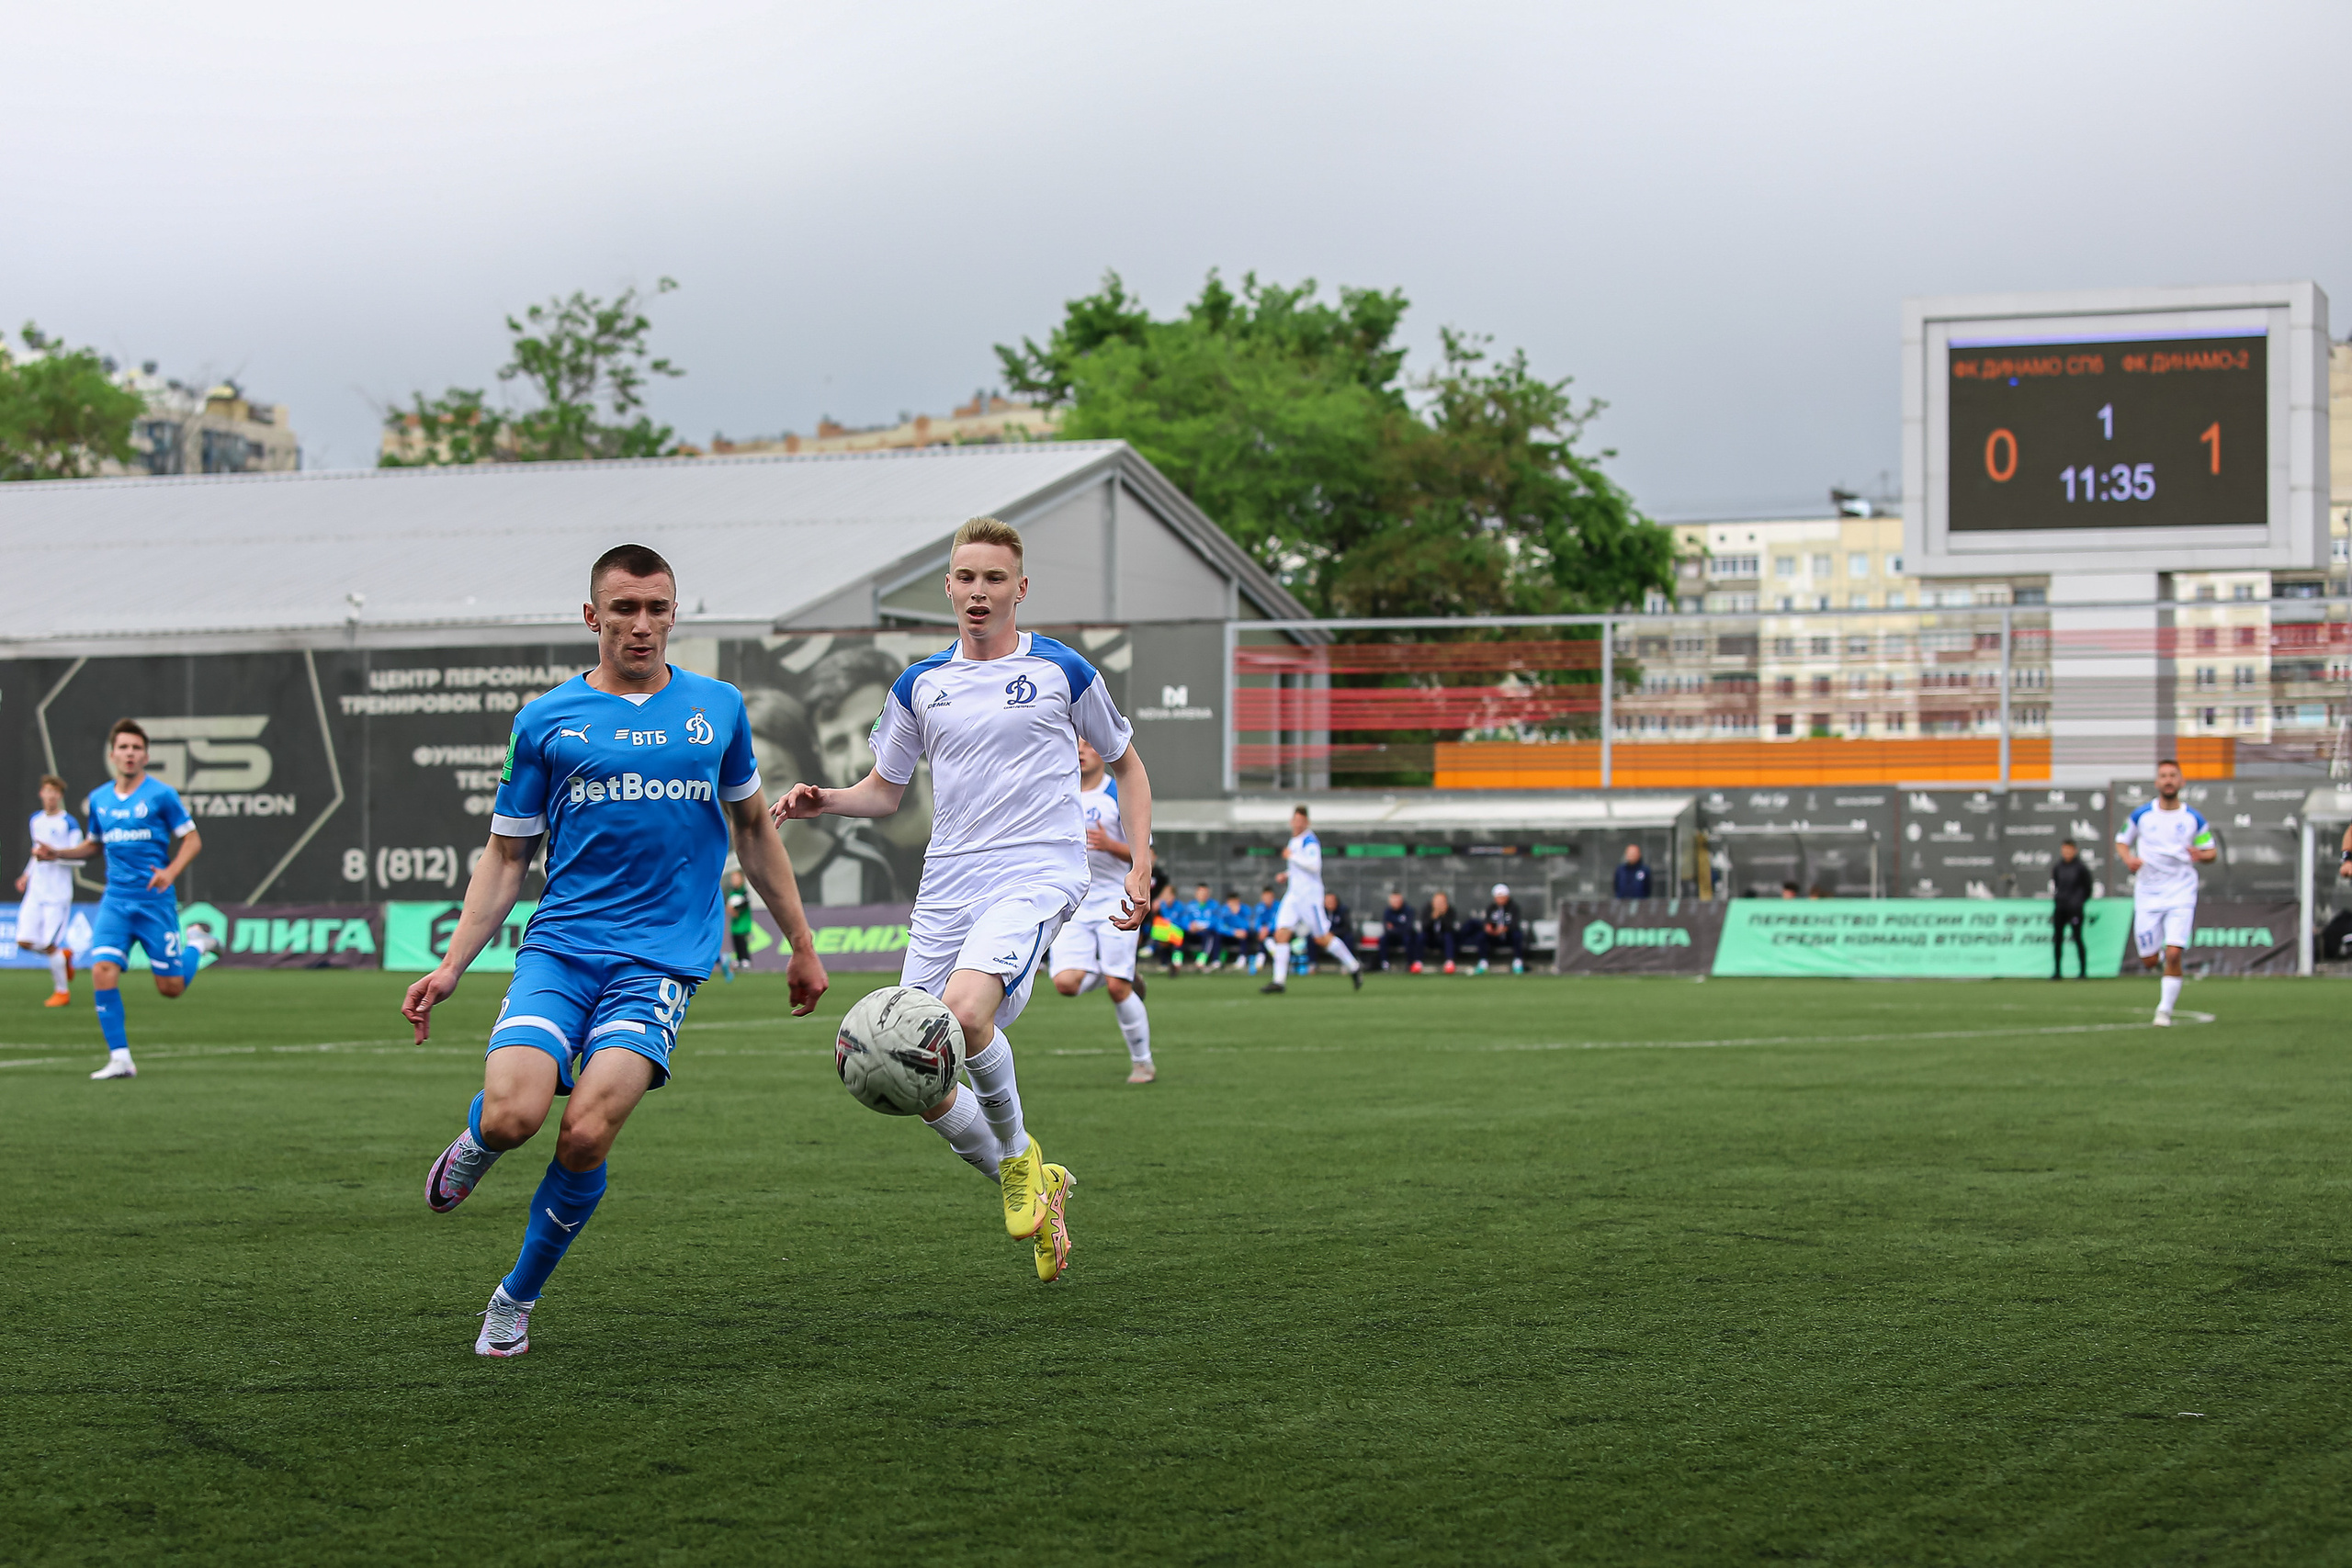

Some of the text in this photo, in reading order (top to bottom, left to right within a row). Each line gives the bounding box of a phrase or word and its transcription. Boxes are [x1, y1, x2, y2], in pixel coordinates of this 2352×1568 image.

[1984, 428, 2018, 482] 0
[2199, 421, 2221, 475] 1
[2060, 462, 2156, 502] 11:35
[369, 663, 597, 692] ЦЕНТР ПЕРСОНАЛ
[338, 693, 481, 715] ТРЕНИРОВОК
[485, 691, 518, 713] ПО
[631, 729, 668, 746] ВТБ
[568, 773, 712, 803] BetBoom
[342, 847, 367, 883] 8
[376, 845, 458, 888] (812)
[231, 918, 378, 955] ЛИГА
[1615, 927, 1691, 947] ЛИГА
[2194, 927, 2275, 948] ЛИГА
